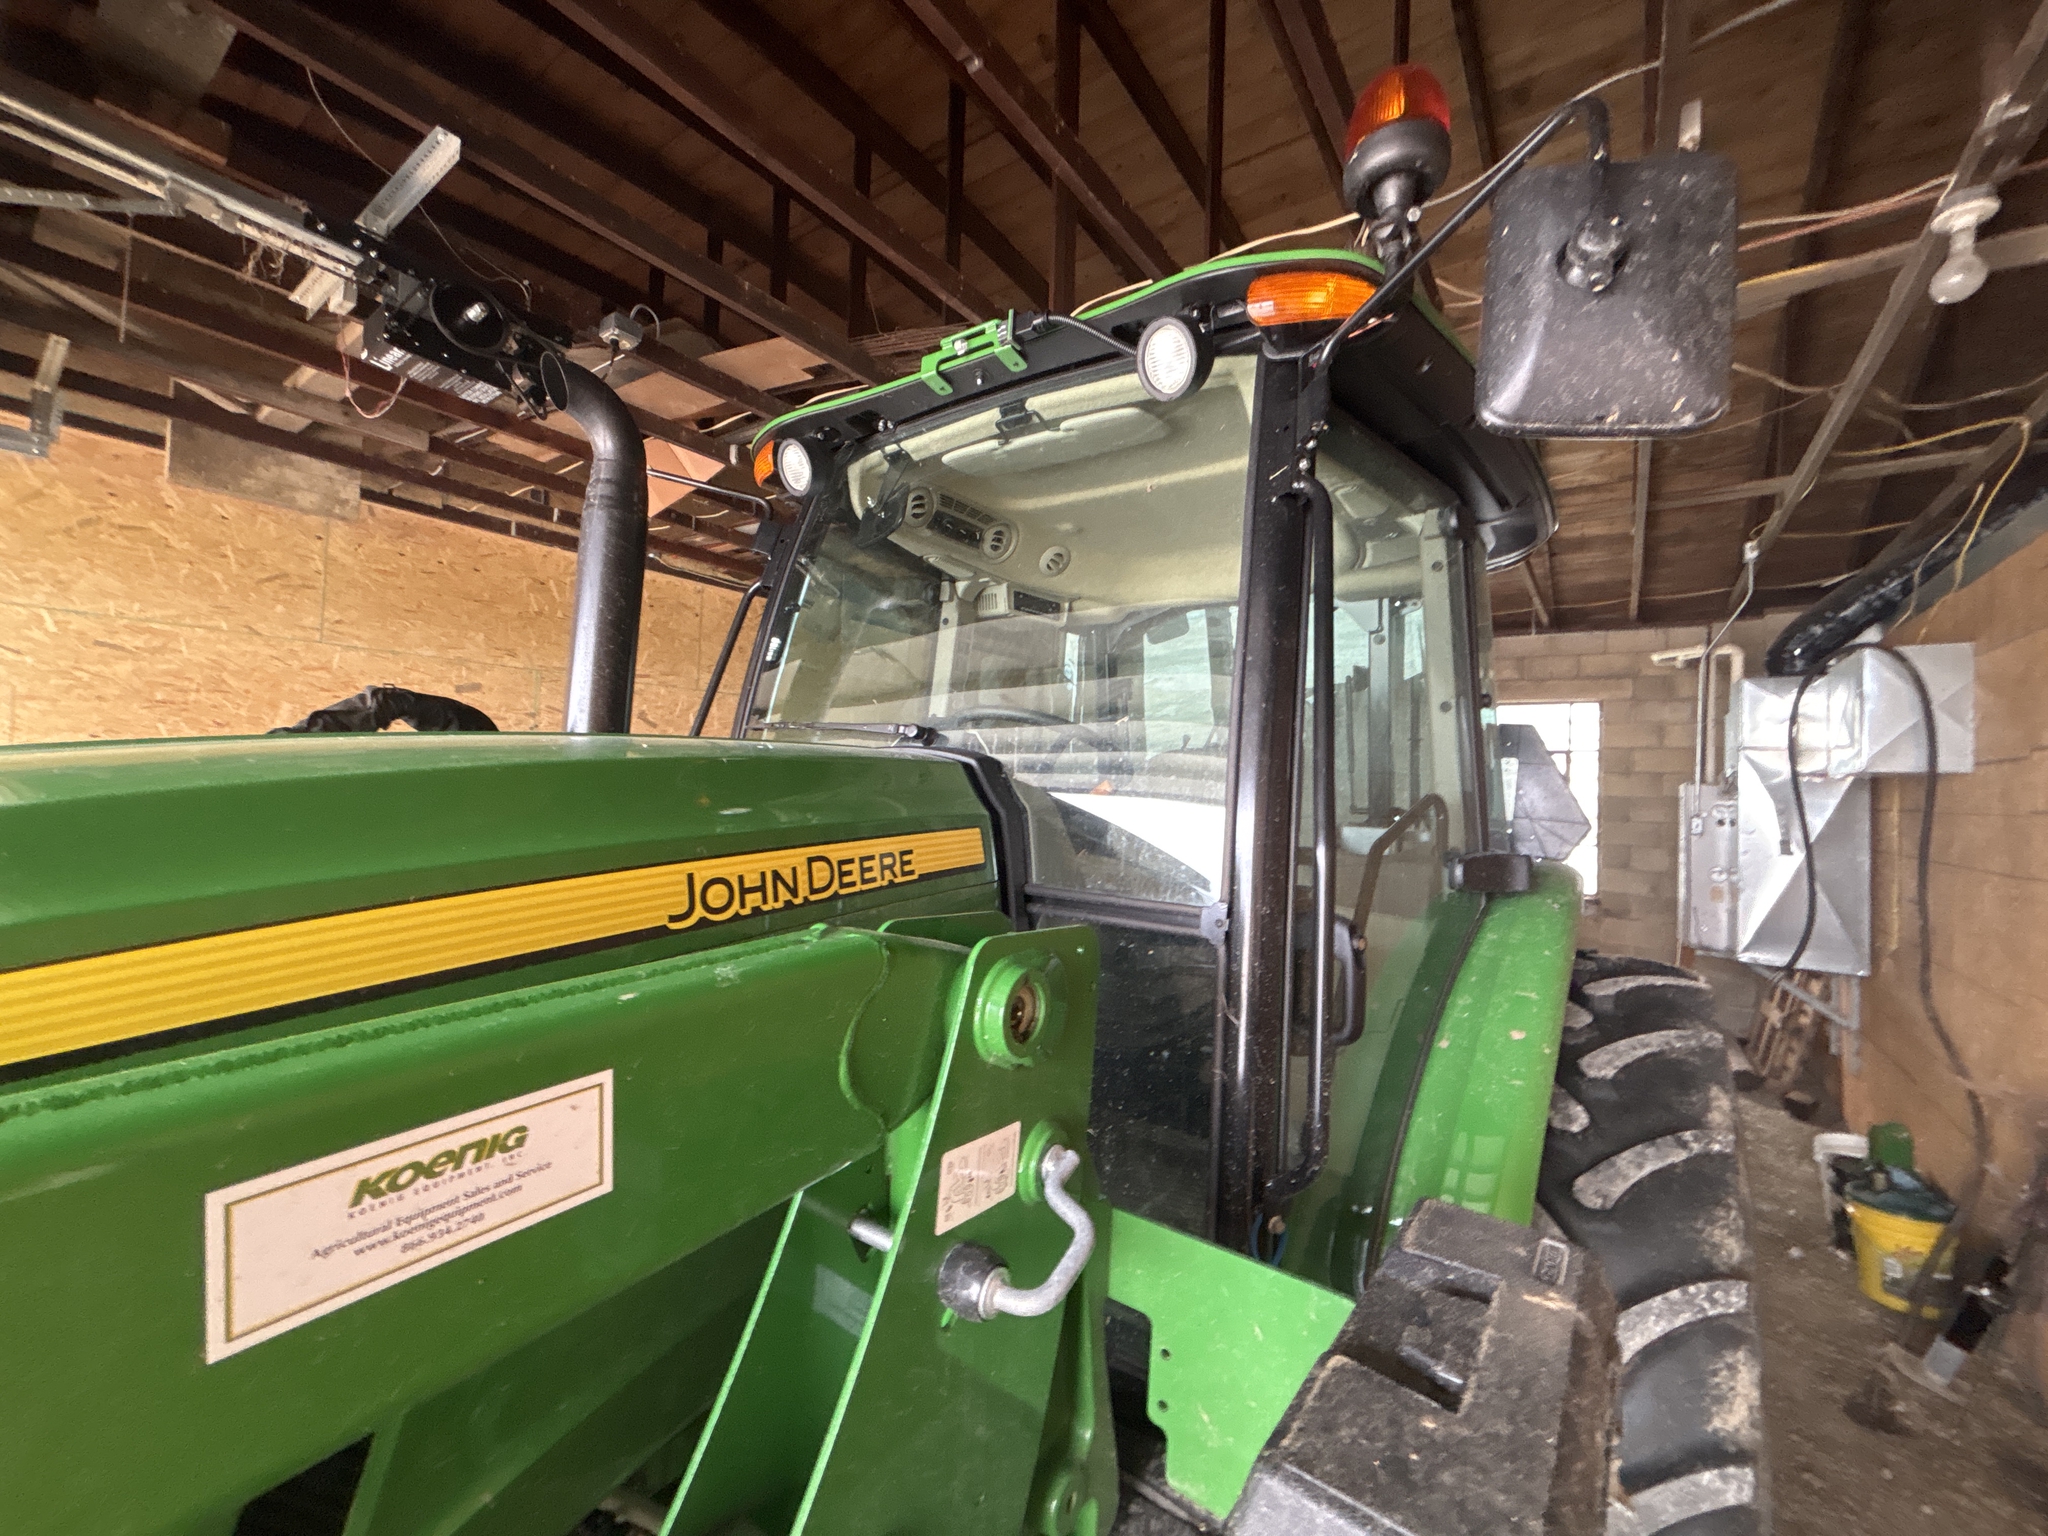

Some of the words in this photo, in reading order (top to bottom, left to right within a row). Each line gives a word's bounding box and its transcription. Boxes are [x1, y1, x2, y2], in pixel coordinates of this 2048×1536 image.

[369, 346, 406, 371] Linear
[668, 866, 799, 923] JOHN
[806, 849, 916, 895] DEERE
[311, 1219, 393, 1258] Agricultural
[396, 1195, 460, 1226] Equipment
[463, 1186, 491, 1200] Sales
[493, 1173, 514, 1189] and
[515, 1161, 553, 1180] Service
[353, 1184, 523, 1256] www.koenigequipment.com
